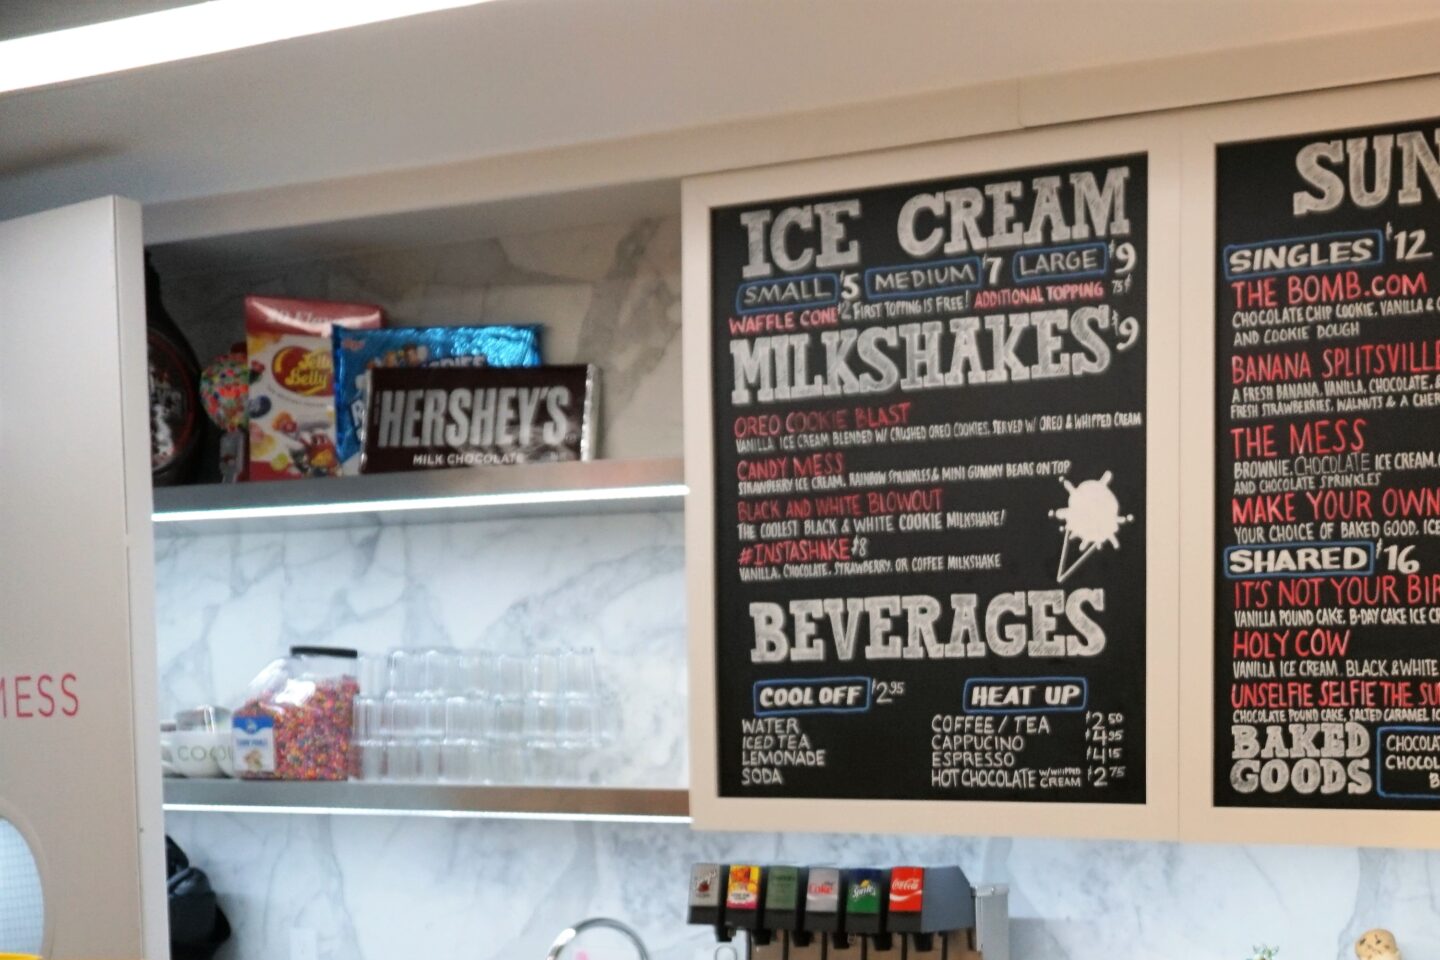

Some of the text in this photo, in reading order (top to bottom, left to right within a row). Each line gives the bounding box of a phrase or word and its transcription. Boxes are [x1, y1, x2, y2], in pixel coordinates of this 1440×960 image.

[740, 166, 1130, 279] ICE CREAM
[1229, 238, 1374, 273] SINGLES
[745, 278, 831, 304] SMALL
[875, 263, 976, 291] MEDIUM
[1020, 249, 1097, 276] LARGE
[1109, 240, 1137, 276] $9
[1232, 271, 1428, 308] THE BOMB.COM
[729, 313, 795, 336] WAFFLE
[800, 309, 838, 328] CONE
[853, 298, 883, 321] FIRST
[923, 298, 934, 314] IS
[935, 290, 970, 312] FREE!
[974, 288, 1044, 309] ADDITIONAL
[1047, 282, 1104, 301] TOPPING
[730, 305, 1139, 405] MILKSHAKES $9
[1232, 352, 1312, 384] BANANA
[378, 386, 569, 447] HERSHEY'S
[734, 402, 911, 438] OREO COOKIE BLAST
[1231, 419, 1367, 459] THE MESS
[413, 453, 527, 465] MILK CHOCOLATE
[737, 452, 844, 480] CANDY MESS
[738, 489, 943, 521] BLACK AND WHITE BLOWOUT
[1232, 493, 1296, 524] MAKE
[1306, 490, 1372, 520] YOUR
[1382, 487, 1440, 516] OWN
[739, 539, 850, 565] #INSTASHAKE
[1229, 546, 1367, 573] SHARED
[1234, 580, 1272, 609] IT'S
[1278, 577, 1326, 607] NOT
[1330, 575, 1400, 605] YOUR
[750, 588, 1106, 663] BEVERAGES
[1233, 628, 1350, 658] HOLY COW
[759, 685, 864, 707] COOL OFF
[971, 685, 1080, 706] HEAT UP
[742, 718, 800, 735] WATER
[932, 715, 994, 734] COFFEE
[1015, 716, 1050, 734] TEA
[1231, 722, 1370, 759] BAKED
[742, 735, 811, 750] ICED TEA
[742, 750, 825, 767] LEMONADE
[932, 735, 1023, 751] CAPPUCINO
[932, 752, 1015, 767] ESPRESSO
[742, 769, 783, 786] SODA
[932, 770, 1036, 788] HOT CHOCOLATE
[1230, 758, 1373, 794] GOODS
